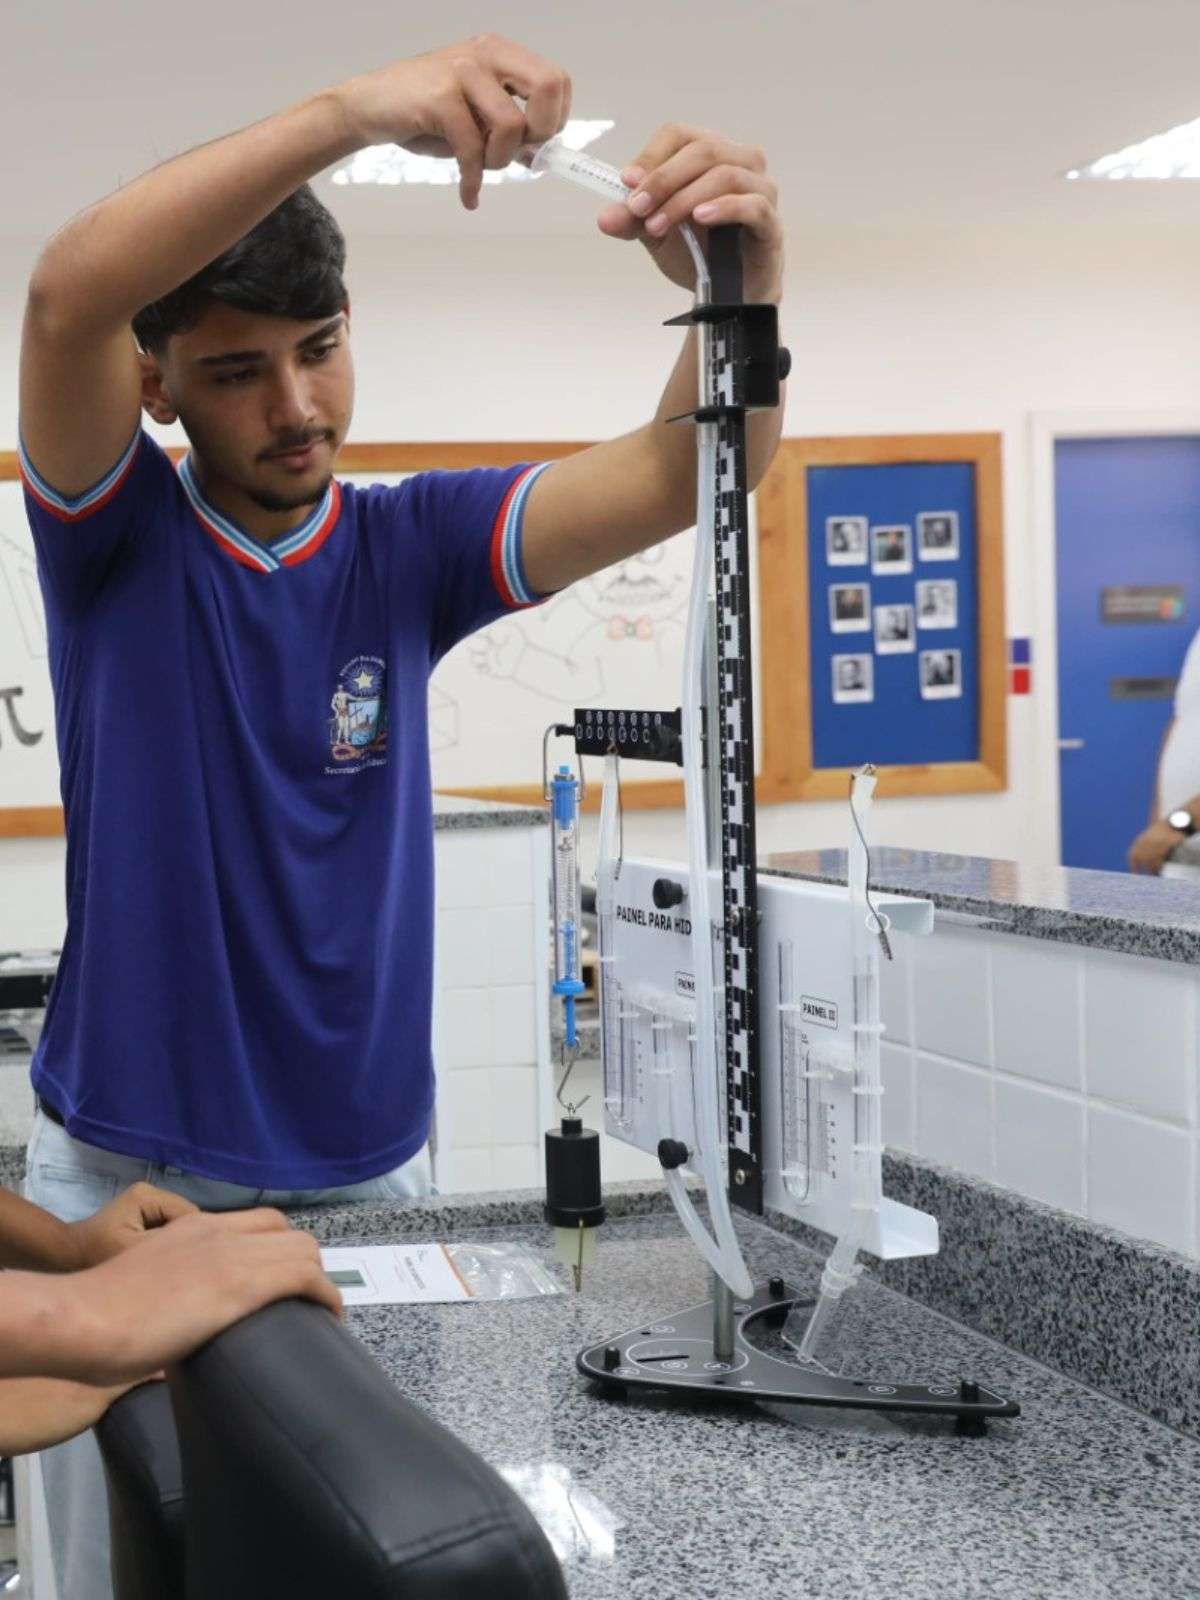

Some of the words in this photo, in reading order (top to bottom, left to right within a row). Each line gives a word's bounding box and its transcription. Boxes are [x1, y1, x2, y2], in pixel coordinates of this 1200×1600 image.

[616, 905, 647, 926] PAINEL
[648, 912, 672, 931] PARA
[803, 1002, 827, 1019] PAINEL
